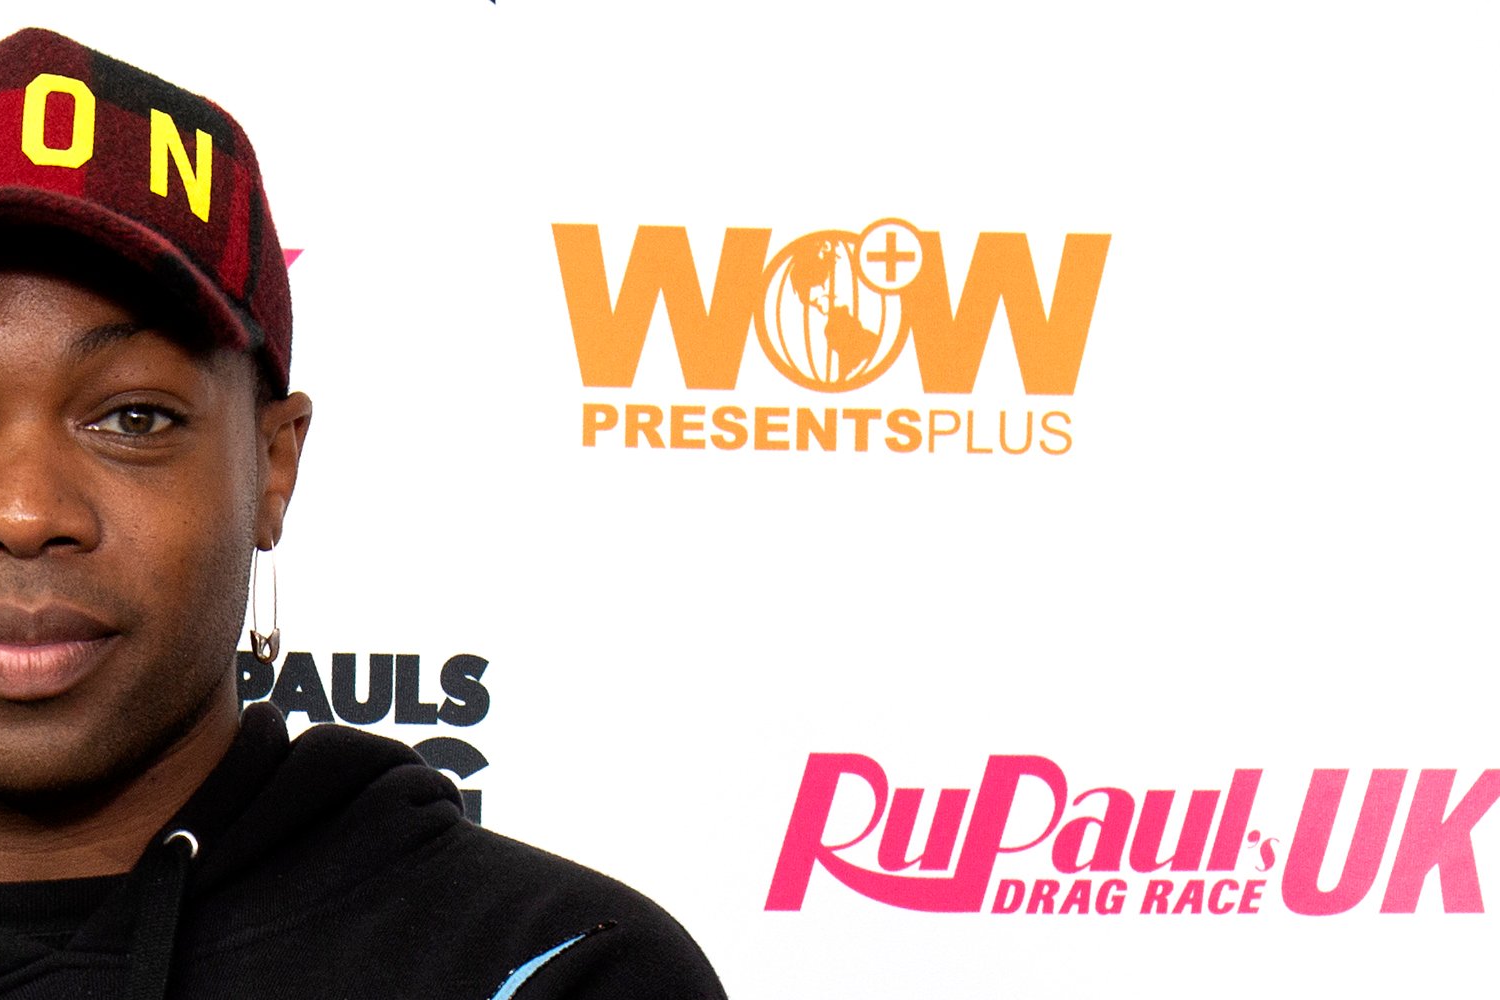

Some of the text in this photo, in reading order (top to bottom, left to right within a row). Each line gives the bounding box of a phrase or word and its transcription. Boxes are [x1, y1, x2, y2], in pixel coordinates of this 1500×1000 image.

[763, 752, 1500, 917] RuPaul's UK
[990, 878, 1268, 916] DRAG RACE
